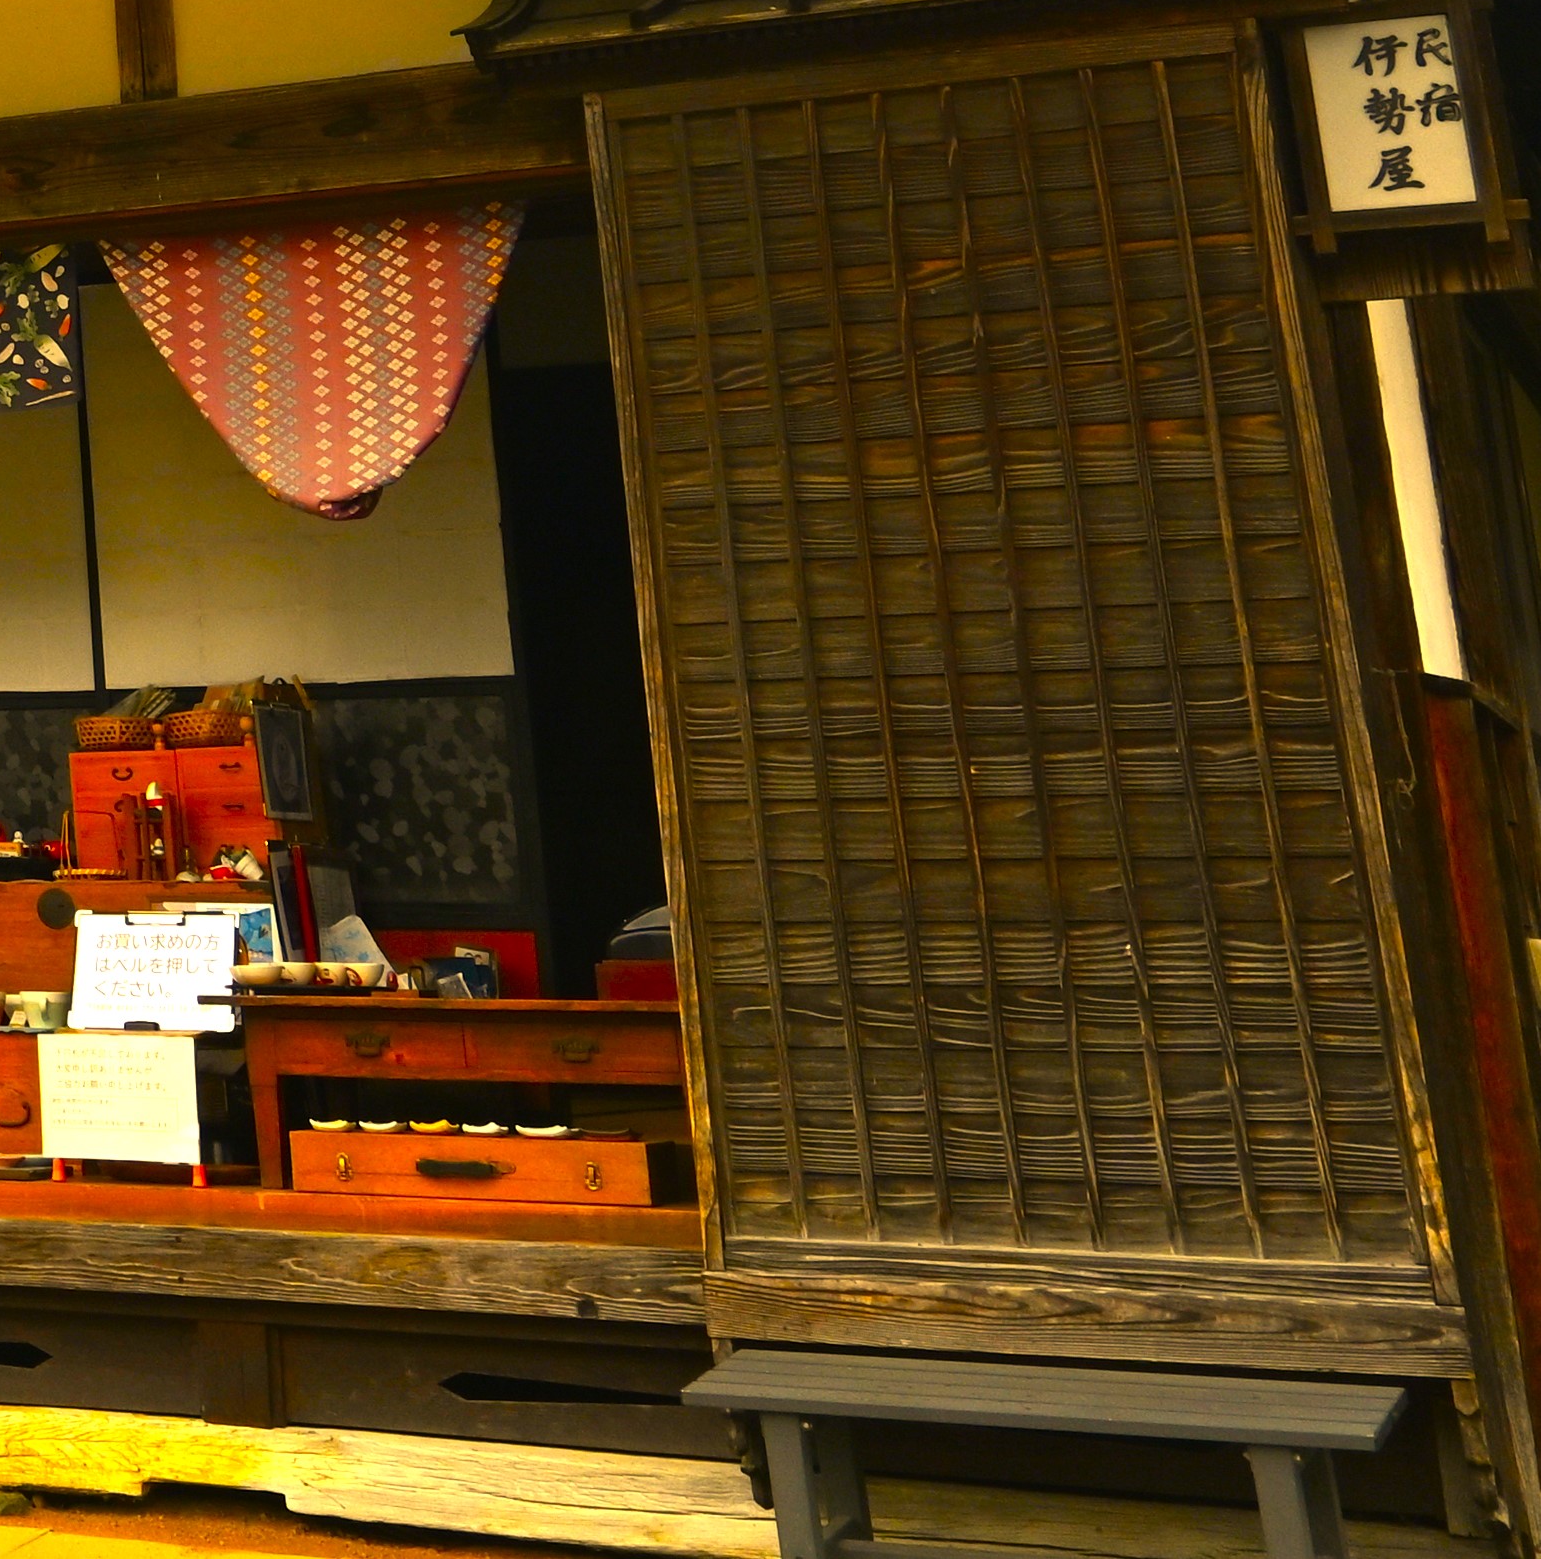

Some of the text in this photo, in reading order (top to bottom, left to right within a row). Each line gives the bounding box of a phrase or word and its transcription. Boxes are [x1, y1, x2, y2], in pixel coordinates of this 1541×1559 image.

[1414, 28, 1462, 127] 民宿
[1352, 34, 1425, 192] 伊勢屋
[96, 933, 220, 951] お買い求めの方
[95, 957, 217, 974] はベルを押して
[94, 980, 173, 998] ください。
